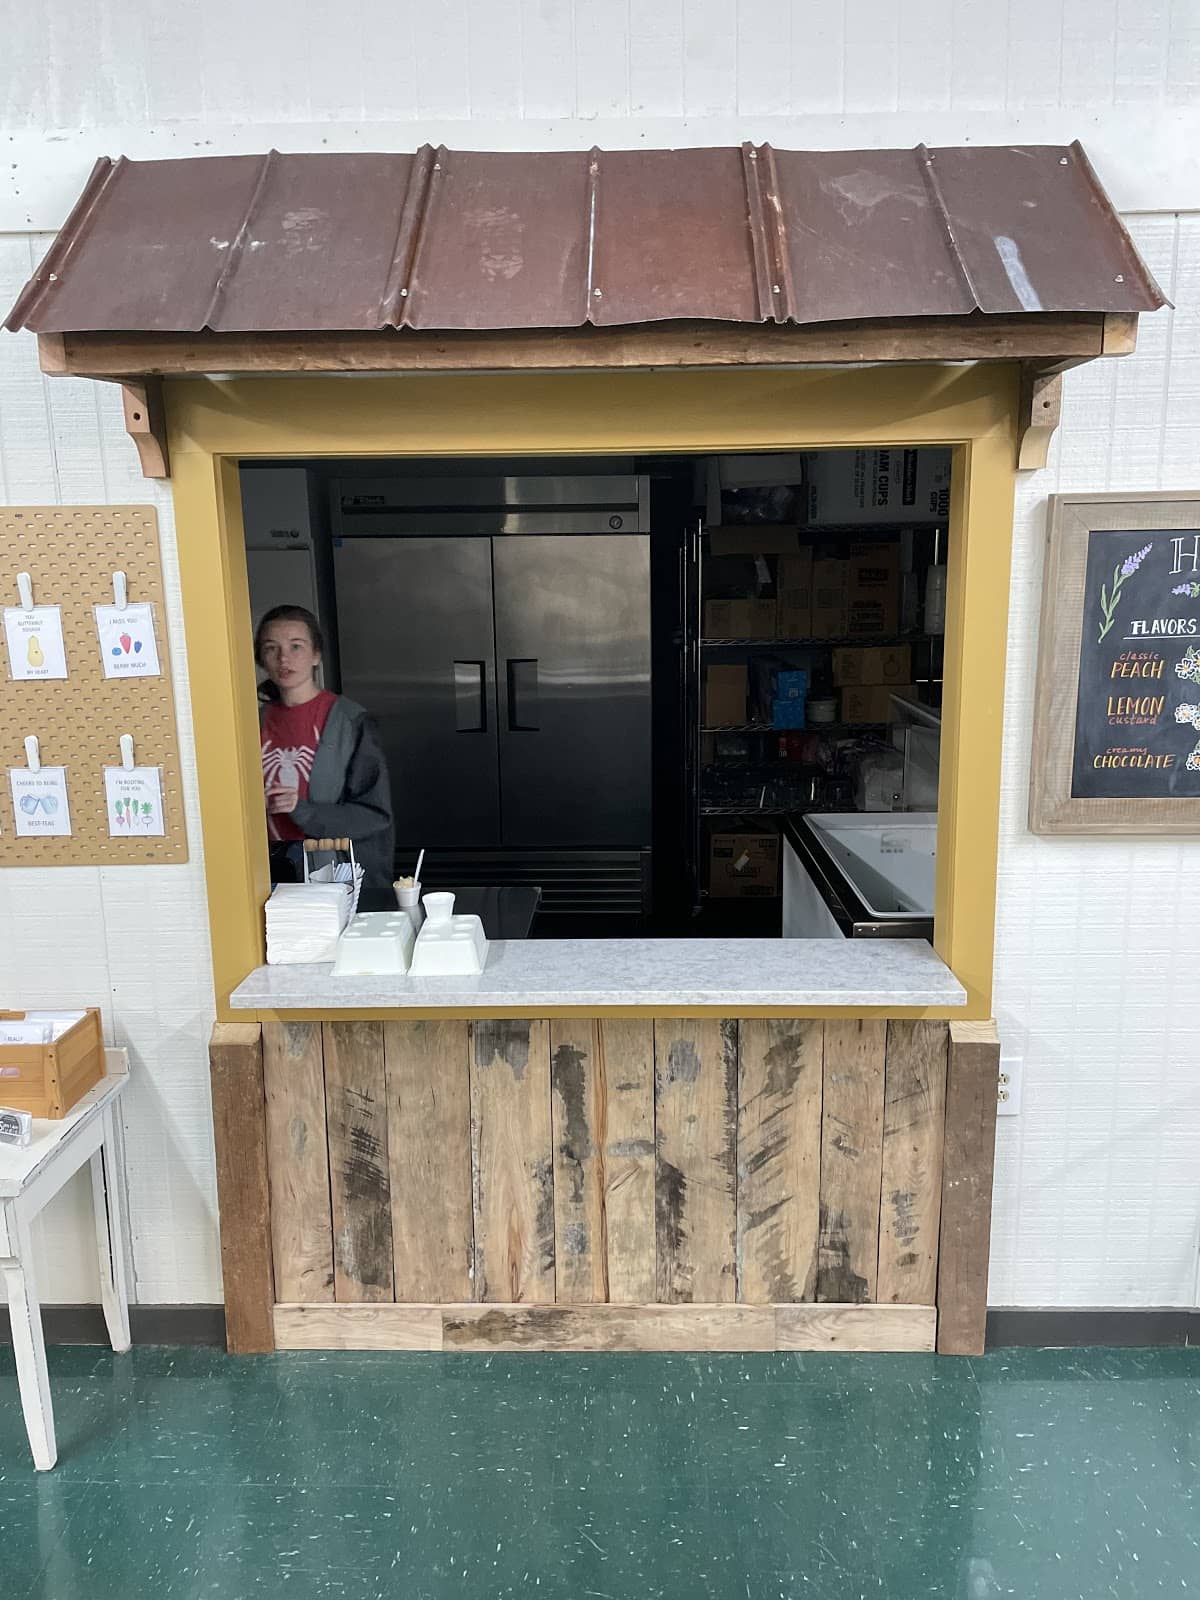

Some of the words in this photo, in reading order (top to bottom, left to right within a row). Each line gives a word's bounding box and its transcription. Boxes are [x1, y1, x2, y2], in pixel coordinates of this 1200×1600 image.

[877, 475, 889, 506] CUPS
[1130, 618, 1198, 636] FLAVORS
[1119, 651, 1161, 661] classic
[1110, 660, 1164, 679] PEACH
[1107, 696, 1165, 717] LEMON
[1108, 715, 1157, 726] custard
[1106, 747, 1148, 755] creamy
[1093, 754, 1177, 769] CHOCOLATE
